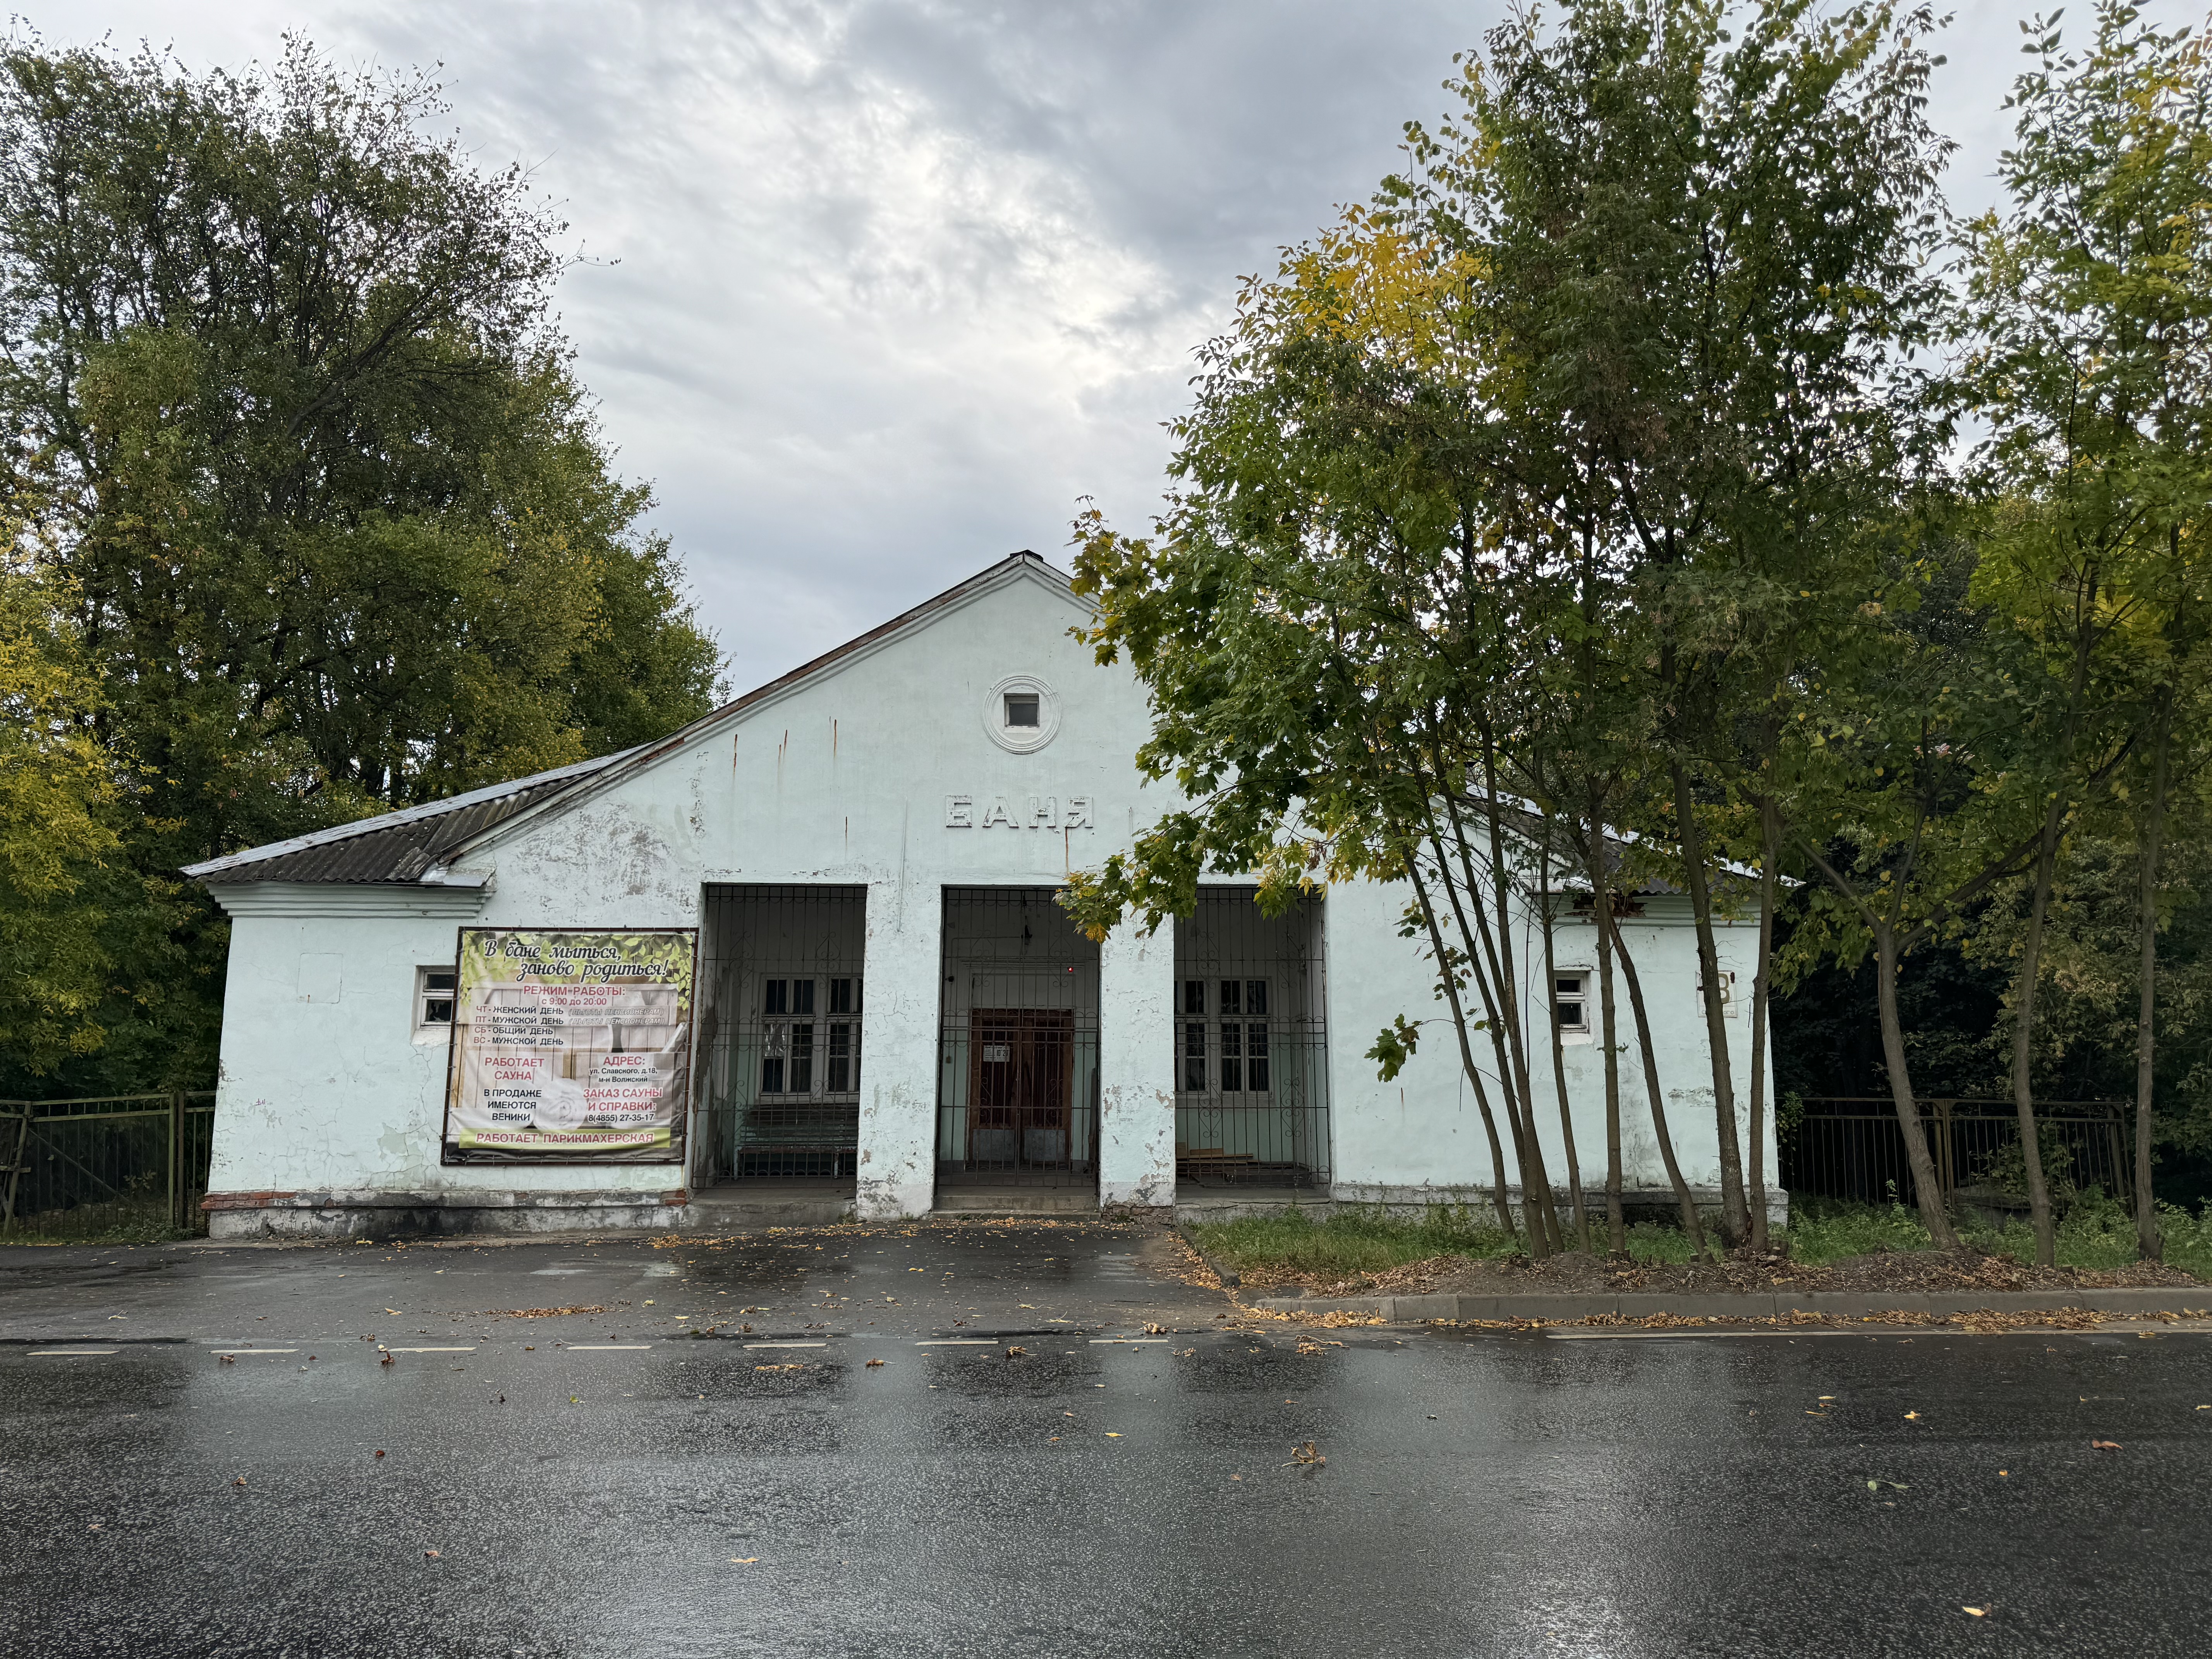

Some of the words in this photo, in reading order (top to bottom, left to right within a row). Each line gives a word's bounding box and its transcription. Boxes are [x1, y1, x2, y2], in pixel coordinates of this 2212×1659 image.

[945, 795, 1093, 828] БАНЯ
[485, 940, 497, 957] В
[505, 942, 541, 957] бане
[549, 947, 621, 961] мыться,
[516, 960, 574, 982] заново
[580, 960, 669, 983] родиться!
[524, 986, 567, 995] РЕЖИМ
[573, 987, 625, 996] РАБОТЫ:
[485, 1058, 544, 1067] РАБОТАЕТ
[603, 1056, 645, 1066] АДРЕС:
[495, 1071, 531, 1080] САУНА
[493, 1089, 542, 1098] ПРОДАЖЕ
[583, 1089, 619, 1098] ЗАКАЗ
[622, 1089, 662, 1097] САУНЫ
[488, 1101, 536, 1109] ИМЕЮТСЯ
[588, 1103, 596, 1111] И
[599, 1102, 656, 1111] СПРАВКИ:
[589, 1114, 617, 1123] 8(4855)
[476, 1133, 538, 1143] РАБОТАЕТ
[543, 1133, 653, 1143] ПАРИКМАХЕРСКАЯ
